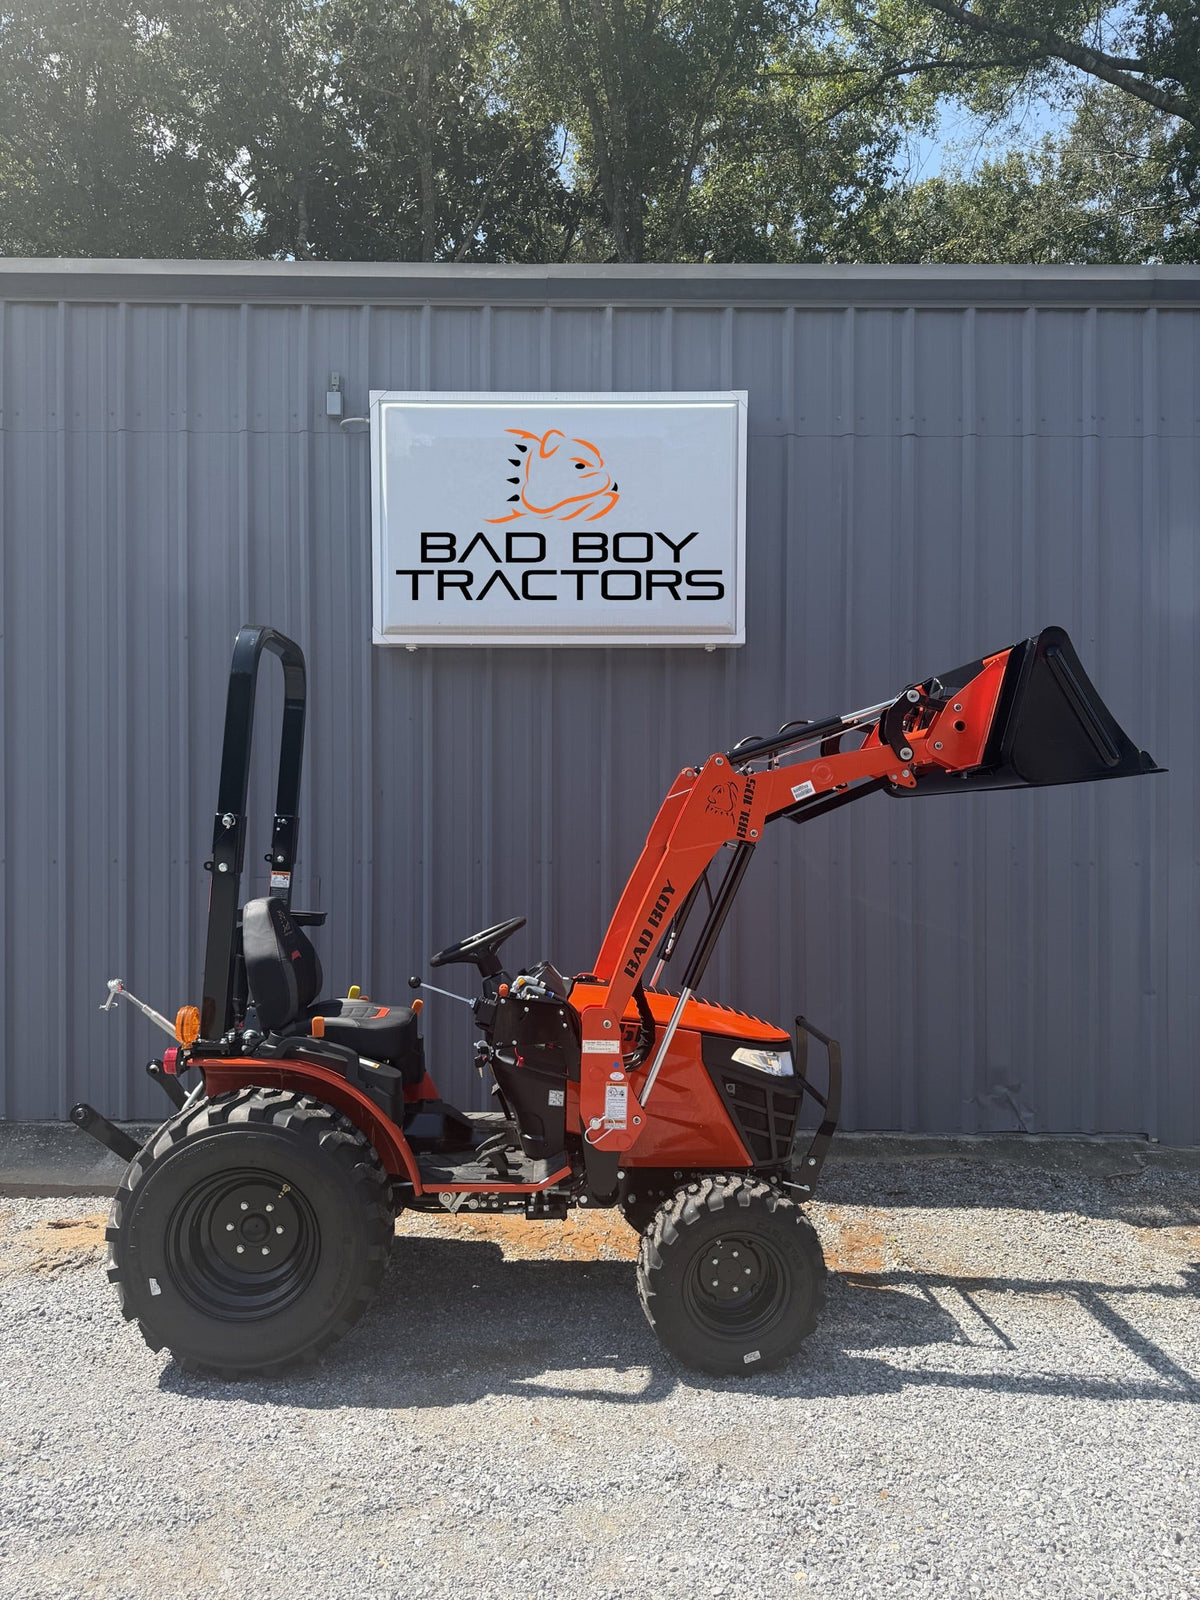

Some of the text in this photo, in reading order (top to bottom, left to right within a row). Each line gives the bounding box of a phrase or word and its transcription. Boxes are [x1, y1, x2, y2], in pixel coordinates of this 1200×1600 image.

[420, 532, 700, 563] BAD BOY
[395, 569, 725, 601] TRACTORS
[624, 879, 676, 978] BAD BOY
